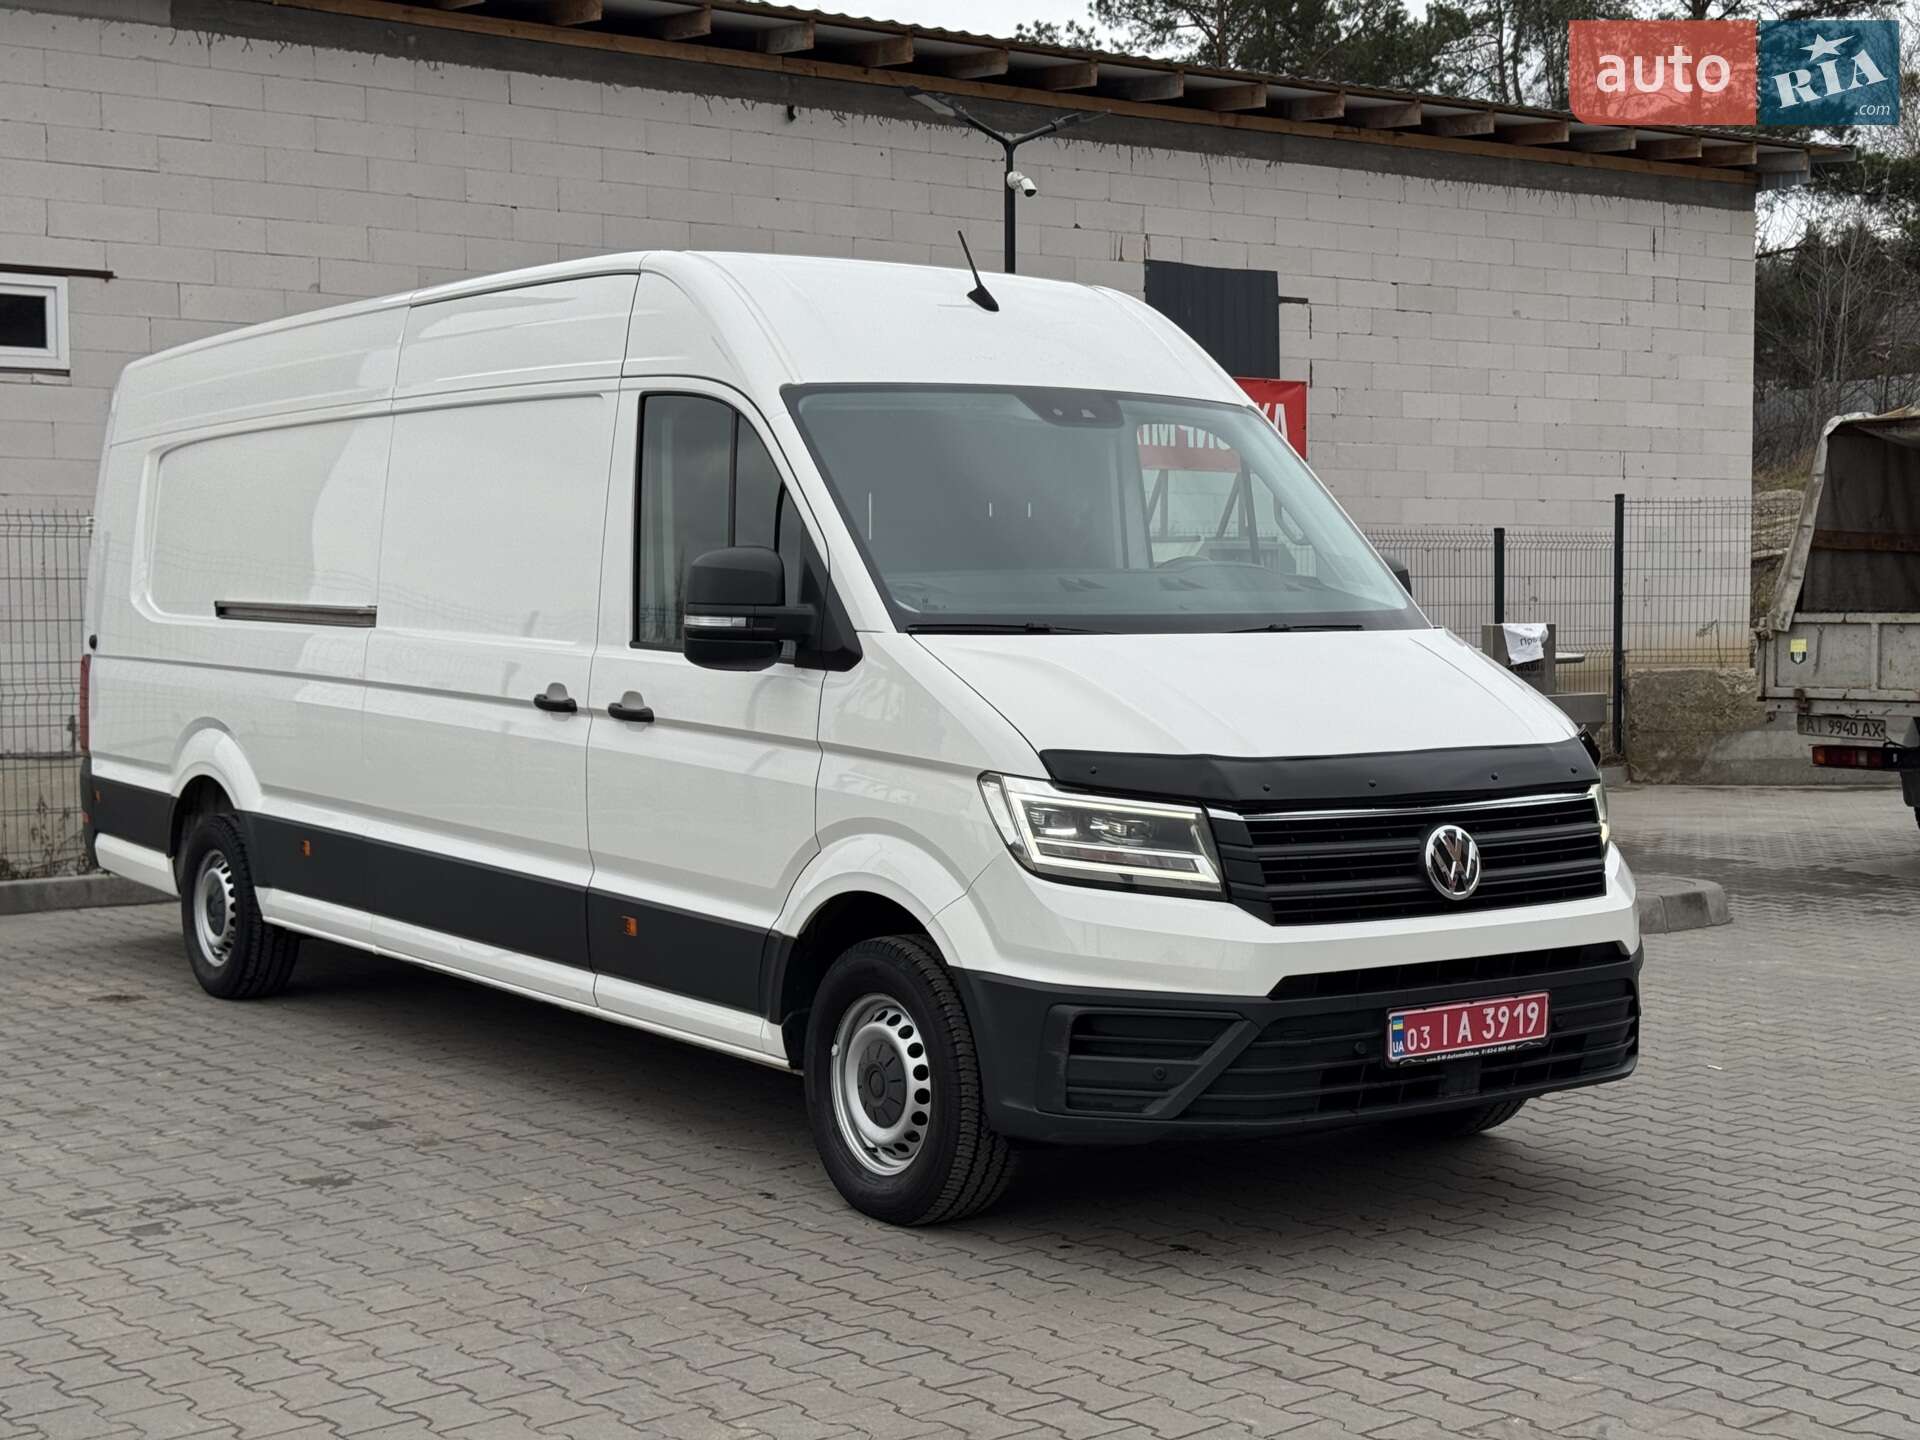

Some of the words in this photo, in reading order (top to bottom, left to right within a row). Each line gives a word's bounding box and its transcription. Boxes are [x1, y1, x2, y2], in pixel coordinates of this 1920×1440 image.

[1828, 720, 1858, 736] 9940
[1861, 722, 1881, 737] AX
[1407, 1025, 1431, 1051] 03
[1443, 1010, 1473, 1046] IA
[1482, 1001, 1540, 1040] 3919
[1392, 1040, 1405, 1053] UA
